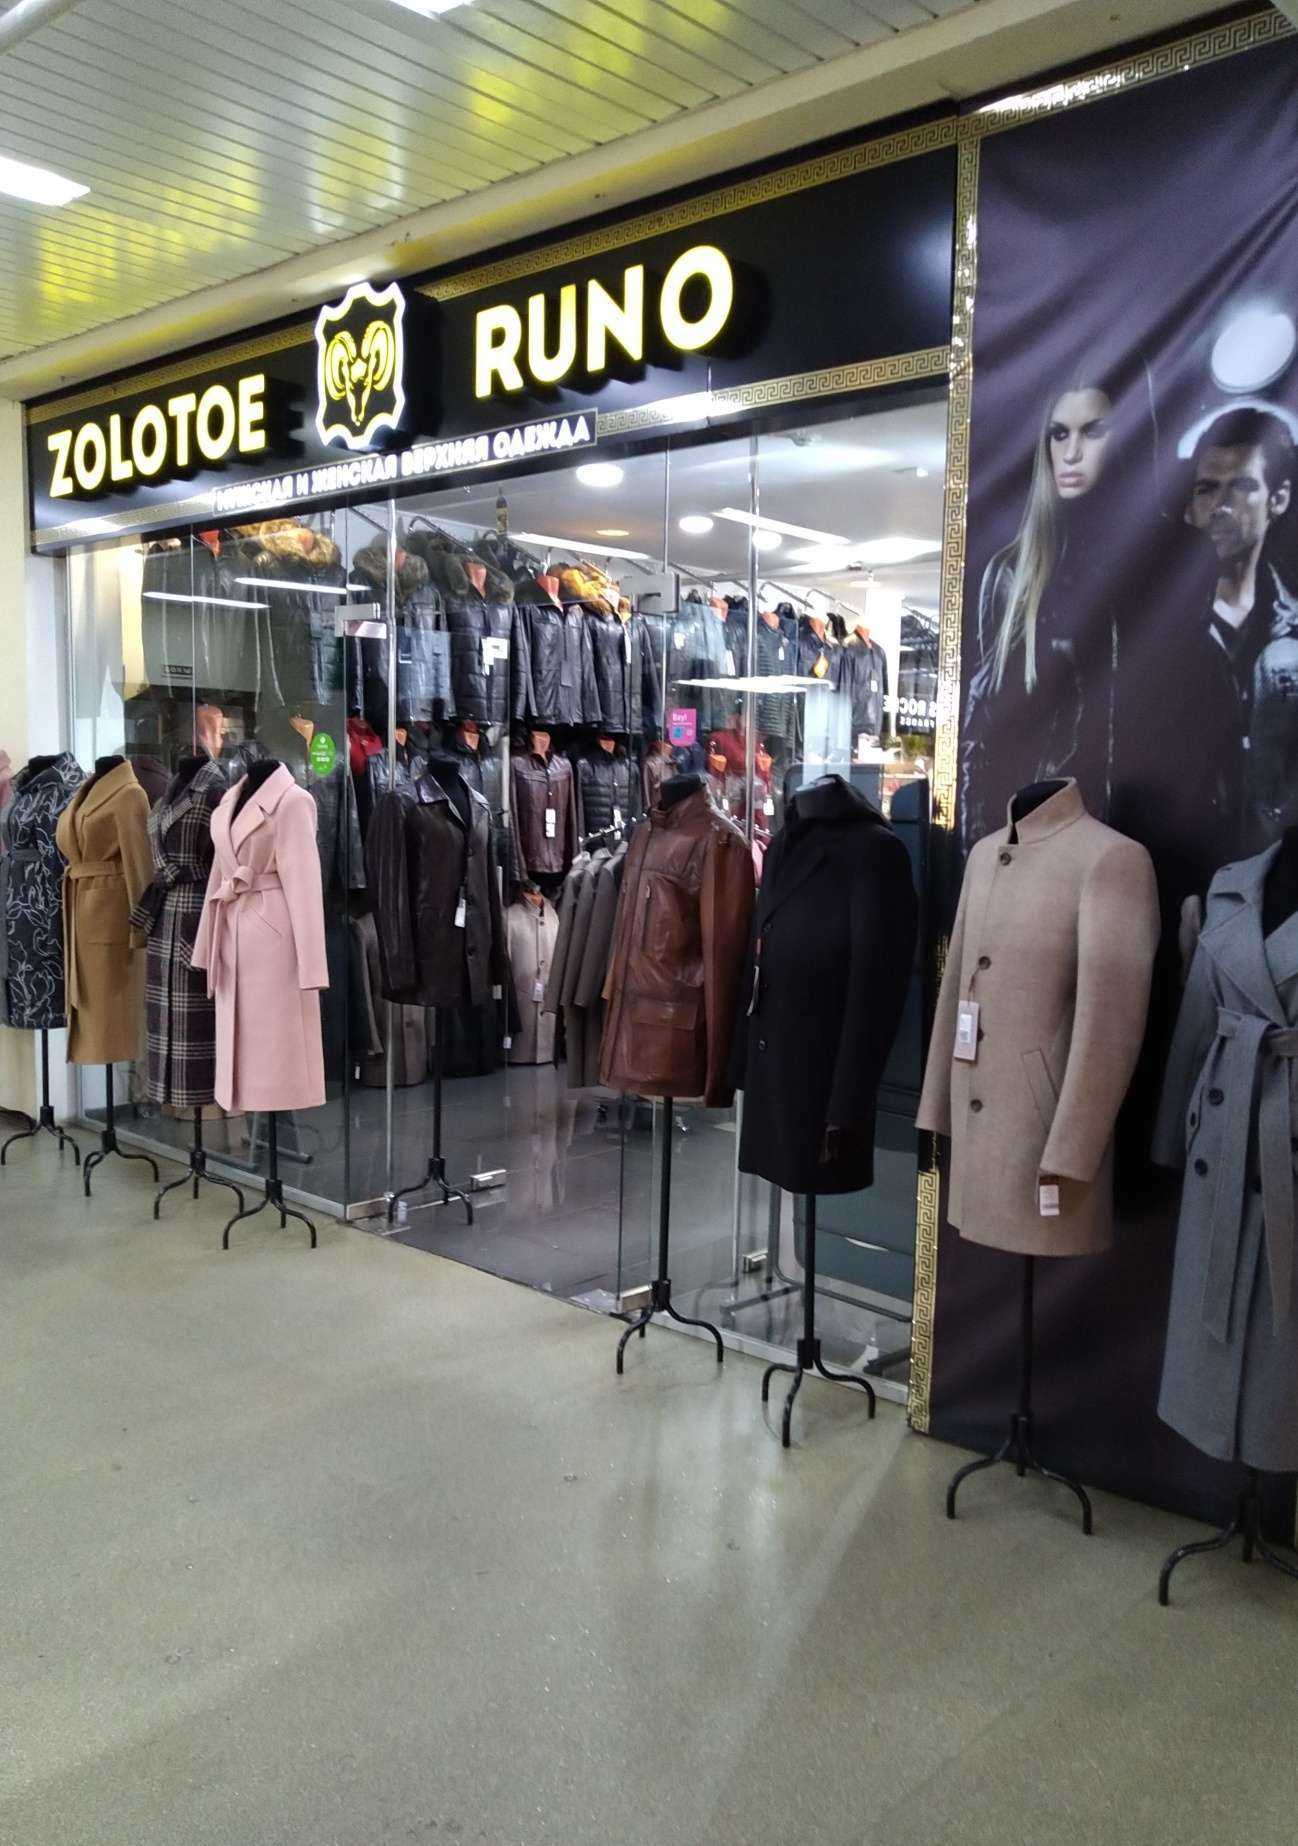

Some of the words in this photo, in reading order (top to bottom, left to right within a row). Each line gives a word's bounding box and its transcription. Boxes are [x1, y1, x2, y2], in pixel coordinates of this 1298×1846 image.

[48, 373, 266, 498] ZOLOTOE
[475, 245, 734, 399] RUNO
[296, 473, 309, 496] И
[311, 453, 398, 494] ЖЕНСКАЯ
[401, 435, 490, 477] ВЕРХНЯЯ
[493, 415, 591, 459] ОДЕЖДА
